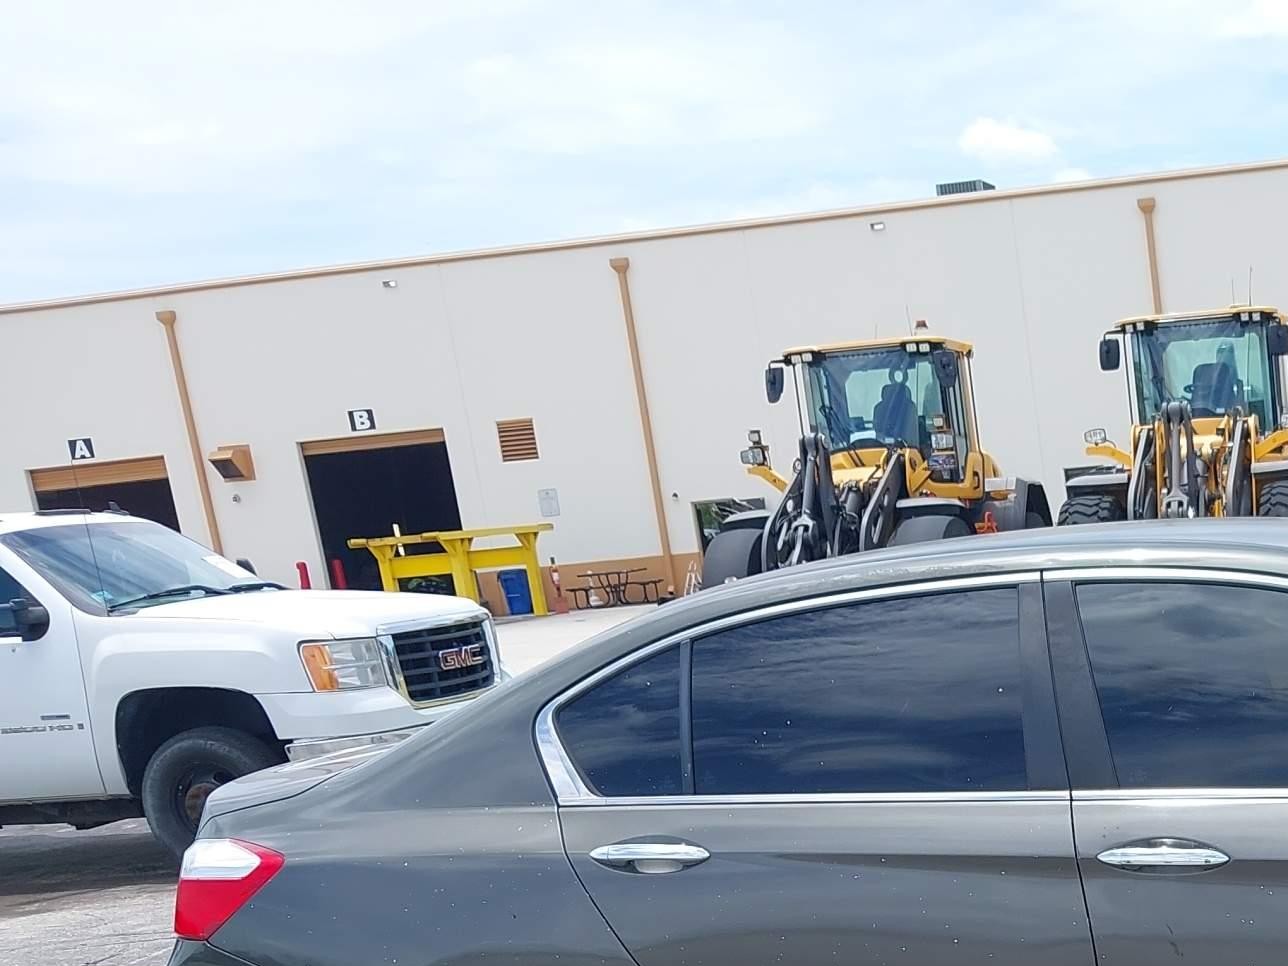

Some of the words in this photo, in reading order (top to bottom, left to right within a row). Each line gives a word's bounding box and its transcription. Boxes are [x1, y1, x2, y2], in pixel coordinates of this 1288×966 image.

[353, 410, 371, 430] B
[74, 439, 92, 459] A
[439, 643, 483, 670] GMC
